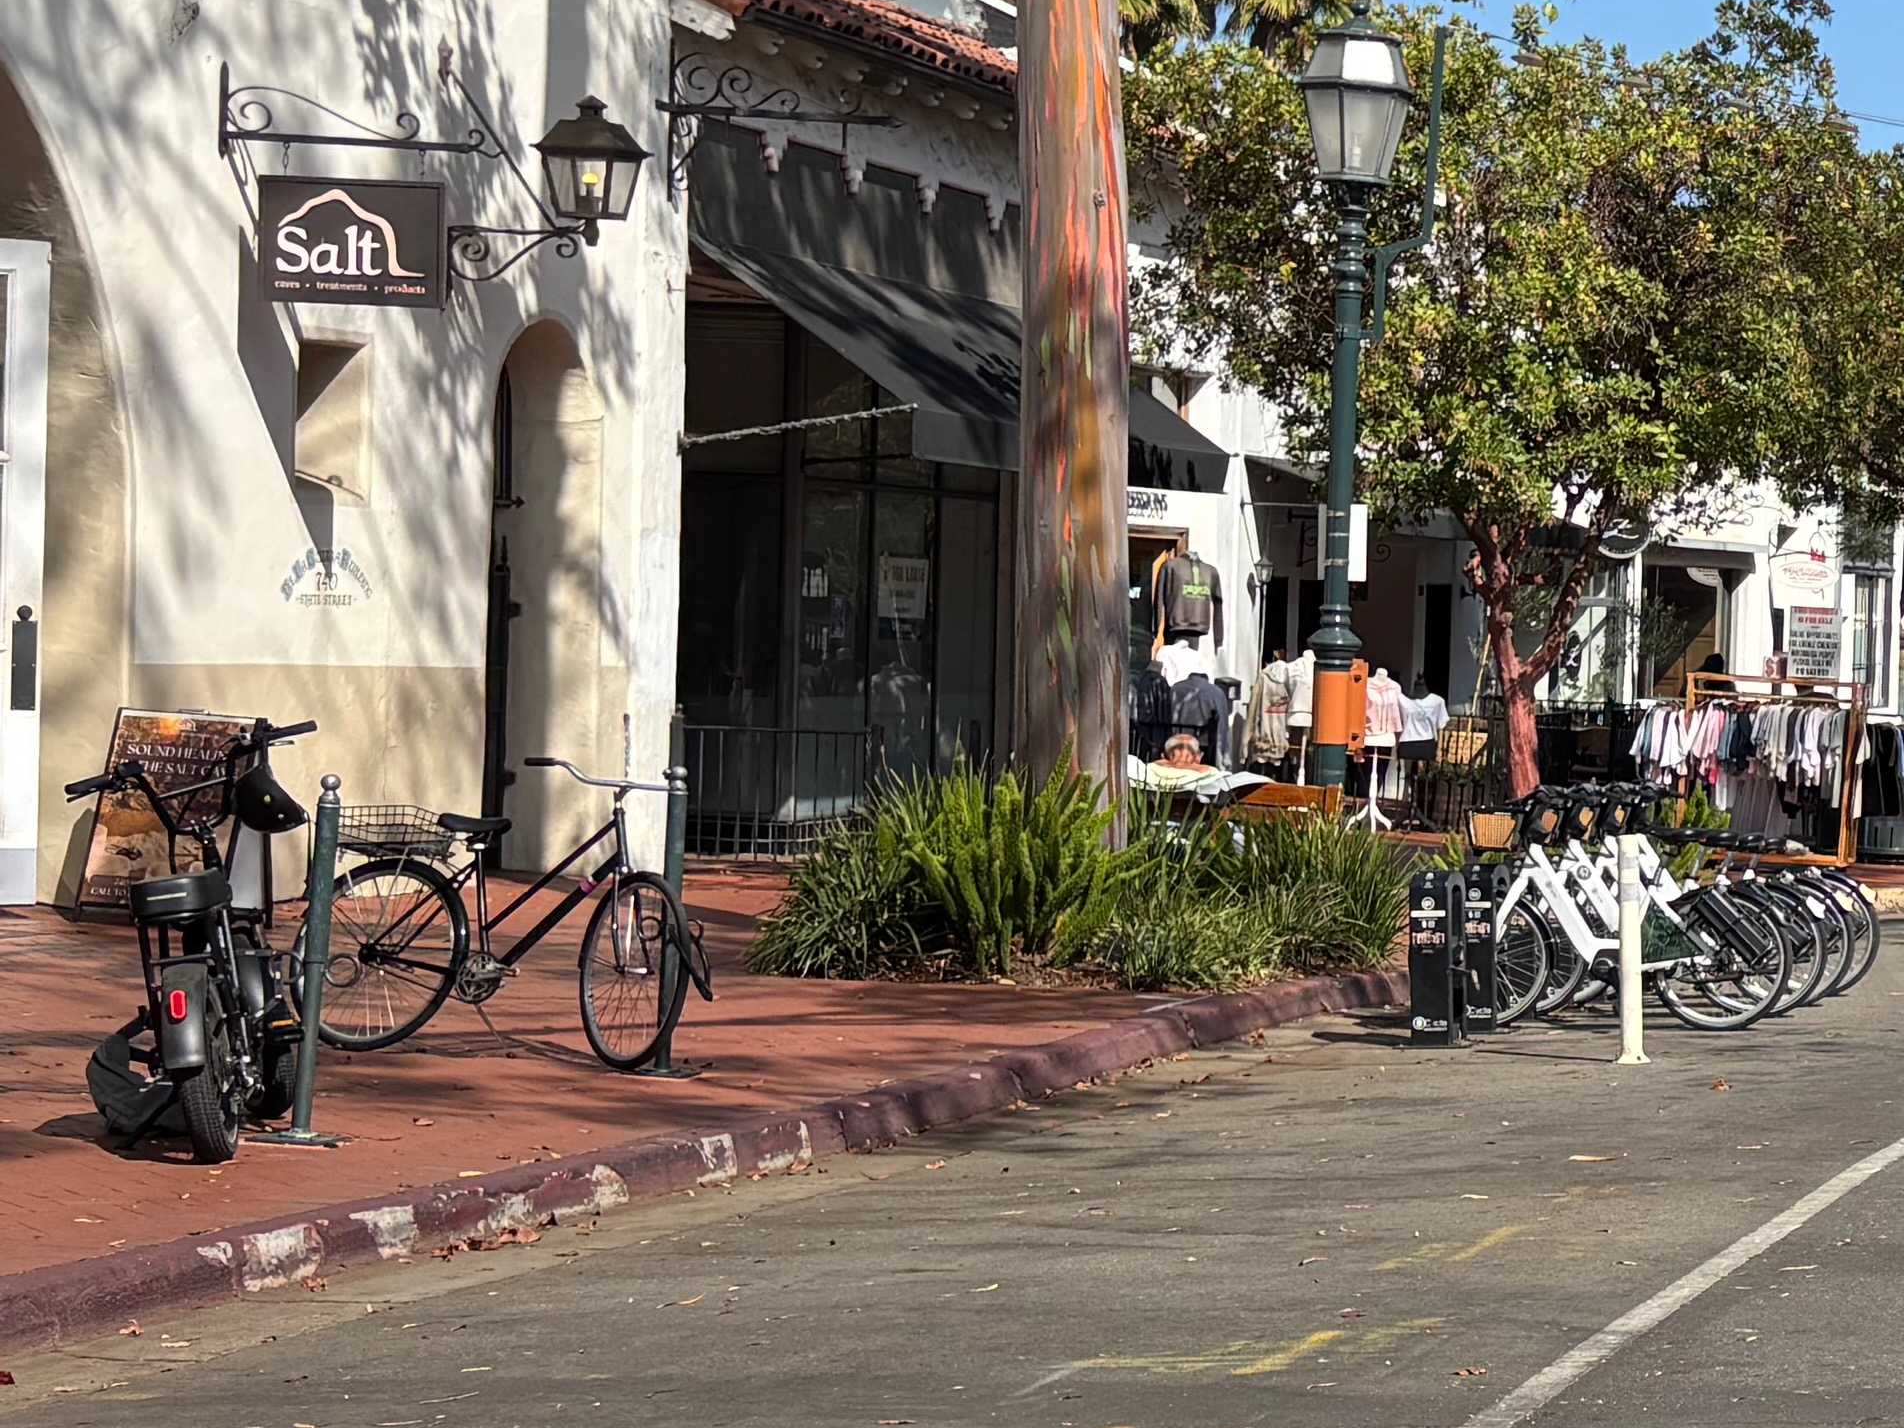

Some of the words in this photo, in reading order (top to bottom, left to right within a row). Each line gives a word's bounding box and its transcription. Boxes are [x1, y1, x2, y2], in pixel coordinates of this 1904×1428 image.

[275, 224, 382, 276] Salt
[316, 281, 367, 292] treatments
[384, 284, 426, 294] products
[323, 594, 353, 607] STREET
[127, 743, 176, 758] SOUND
[177, 747, 229, 761] HEALIN
[139, 760, 164, 772] THE
[165, 762, 199, 775] SALT
